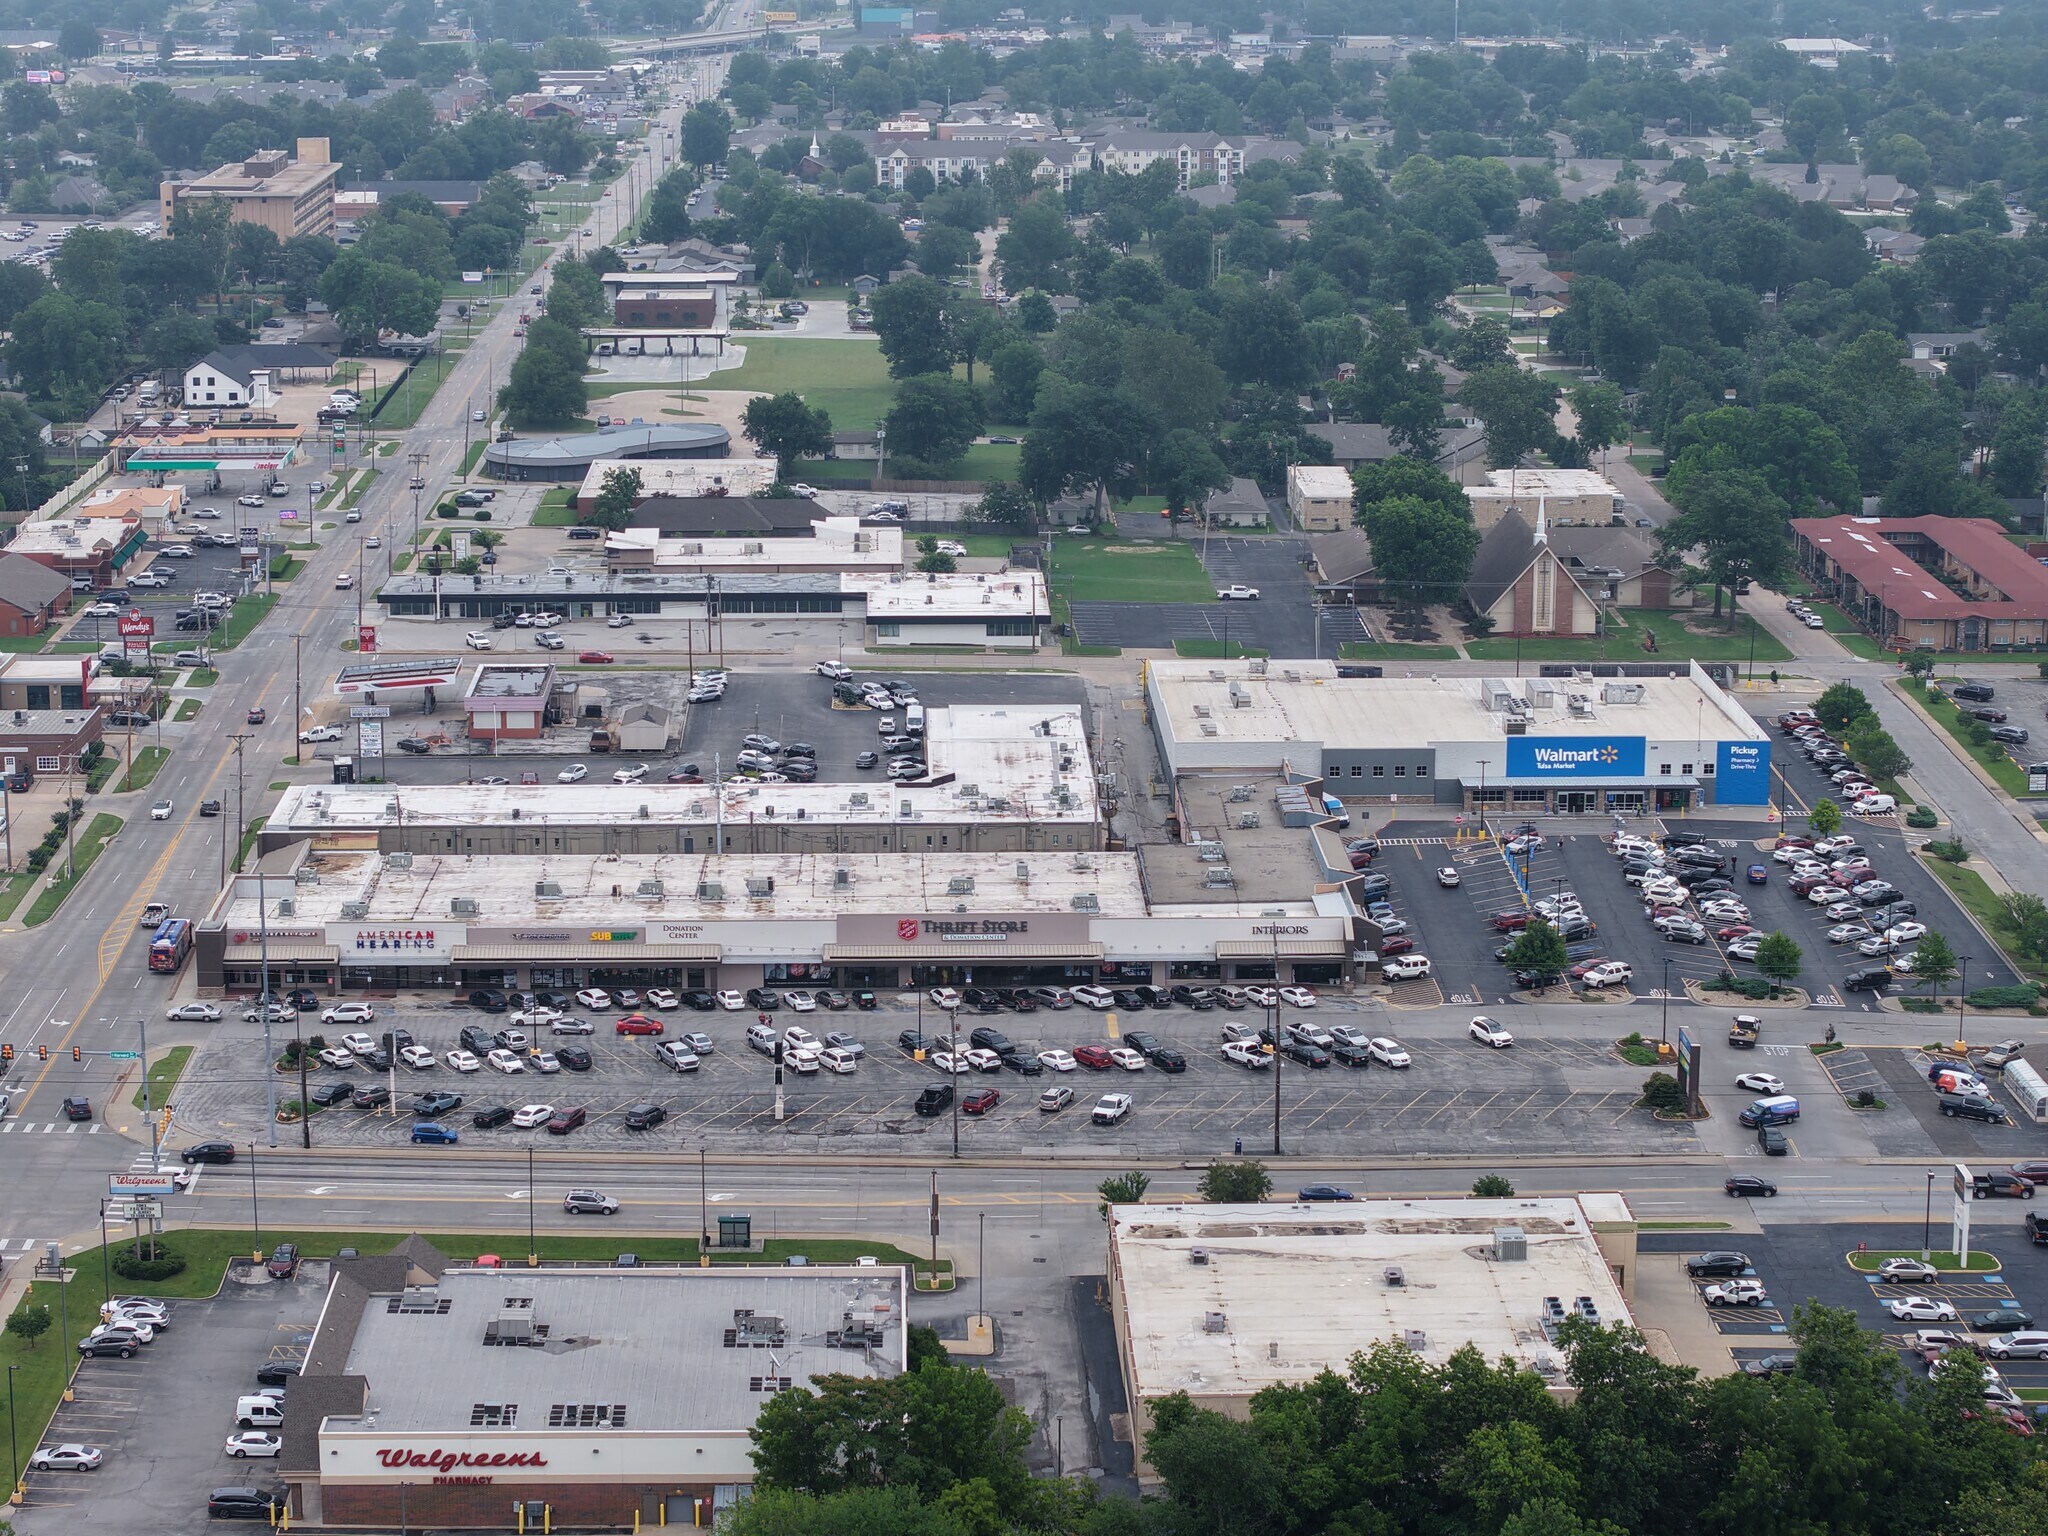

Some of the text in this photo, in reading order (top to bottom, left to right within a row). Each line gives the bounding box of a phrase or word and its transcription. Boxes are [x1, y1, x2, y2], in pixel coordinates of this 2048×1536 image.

[122, 621, 150, 634] Wendy's
[1534, 748, 1599, 762] Walmart
[1730, 746, 1759, 756] Pickup
[662, 924, 704, 932] DONATION
[921, 919, 1028, 933] THRIFT STORE
[1252, 925, 1309, 935] INTERIORS
[356, 930, 434, 940] AMERICAN
[668, 931, 698, 939] CENTER
[356, 940, 435, 949] HEARING
[1450, 994, 1473, 1003] STOP
[1816, 994, 1839, 1004] STOP
[1763, 1046, 1790, 1057] STOP
[115, 1175, 167, 1187] Walgreens
[376, 1448, 548, 1473] Walgreens
[433, 1476, 493, 1485] PHARMACY
